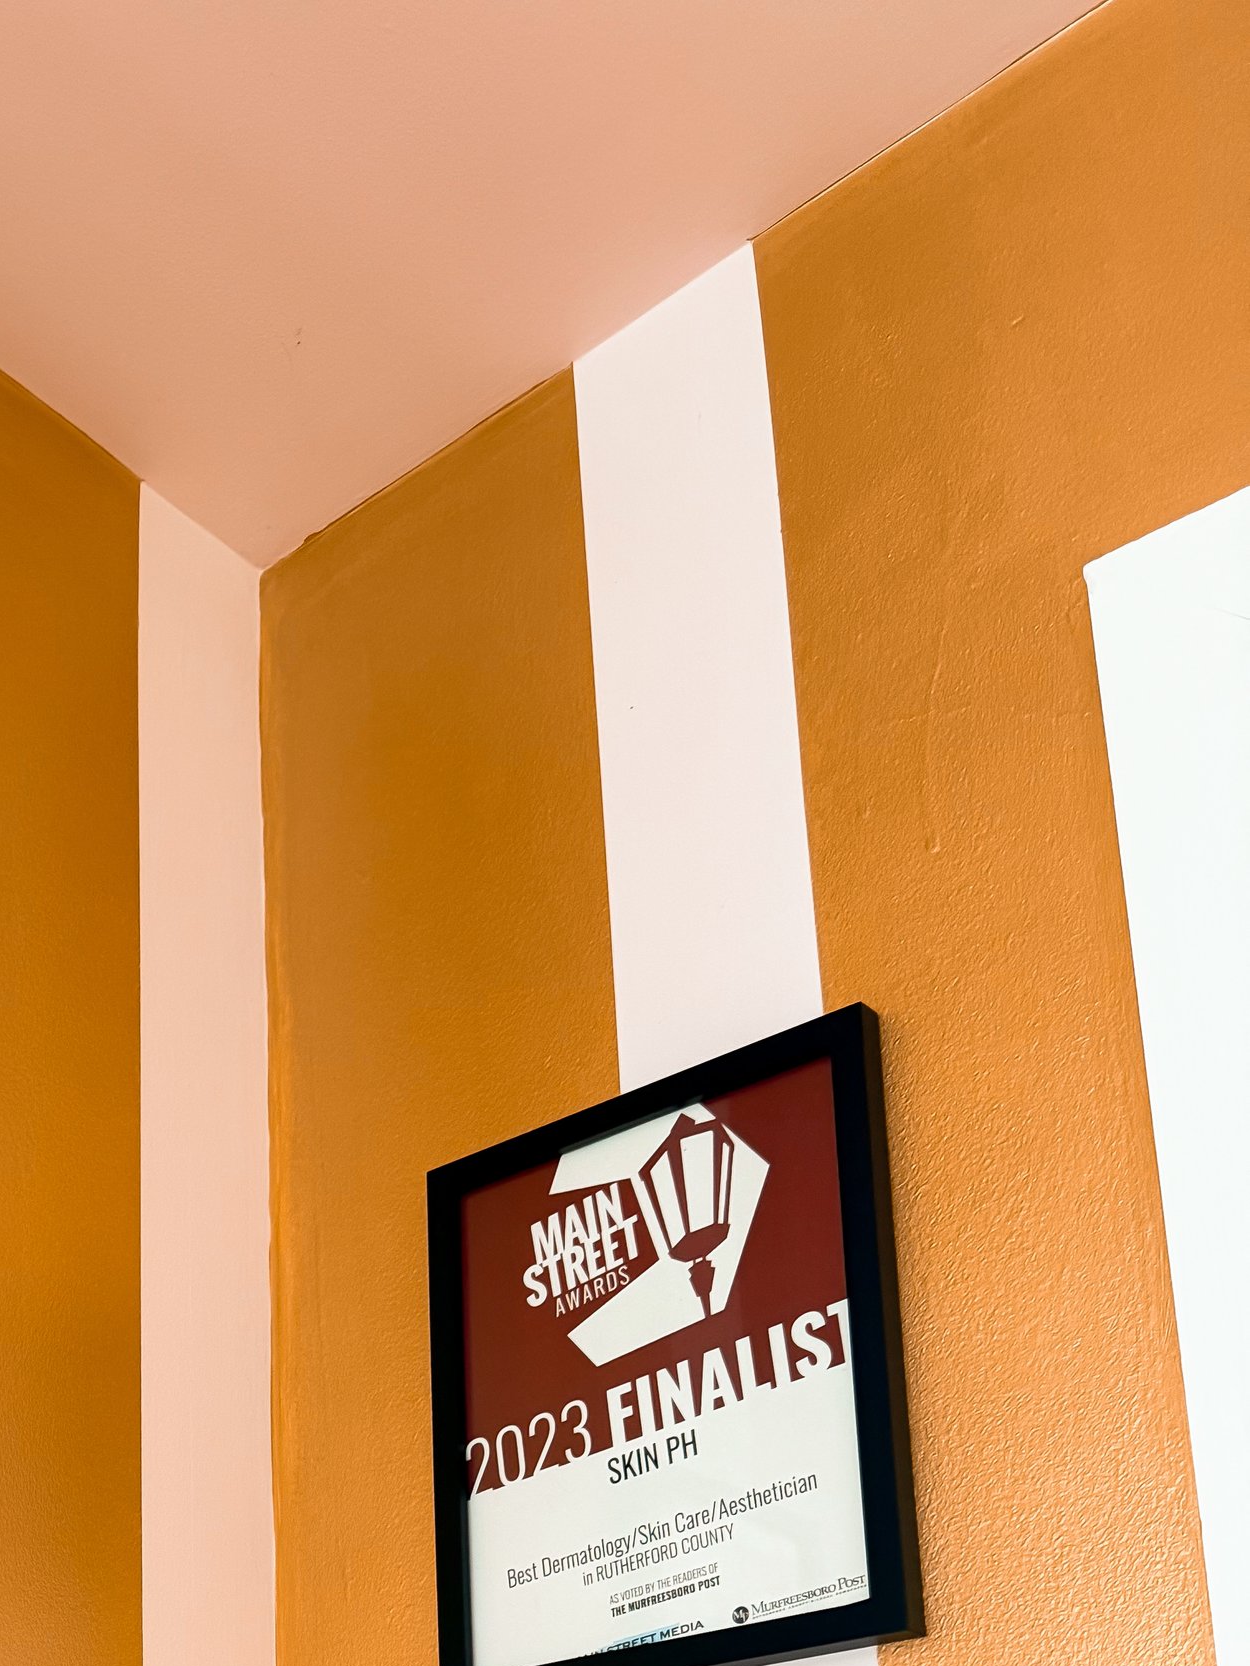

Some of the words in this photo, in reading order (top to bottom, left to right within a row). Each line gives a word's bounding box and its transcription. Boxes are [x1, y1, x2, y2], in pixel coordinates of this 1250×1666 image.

[530, 1182, 626, 1268] MAIN
[522, 1214, 639, 1308] STREET
[555, 1265, 631, 1318] AWARDS
[466, 1399, 592, 1498] 2023
[606, 1298, 850, 1448] FINALIST
[607, 1442, 660, 1485] SKIN
[666, 1428, 698, 1465] PH
[507, 1566, 539, 1589] Best
[541, 1521, 671, 1578] Dermatology/Skin
[674, 1473, 818, 1534] Care/Aesthetician
[582, 1571, 597, 1587] in
[597, 1541, 678, 1580] RUTHERFORD
[681, 1523, 734, 1556] COUNTY
[609, 1594, 620, 1605] AS
[620, 1586, 644, 1602] VOTED
[645, 1581, 655, 1593] BY
[657, 1576, 671, 1590] THE
[672, 1566, 707, 1585] READERS
[708, 1562, 719, 1574] OF
[610, 1604, 627, 1618] THE
[628, 1583, 696, 1613] MURFREESBORO
[698, 1575, 721, 1591] POST
[751, 1584, 837, 1616] MURFREESBORO
[837, 1574, 866, 1591] POST
[659, 1620, 705, 1641] MEDIA
